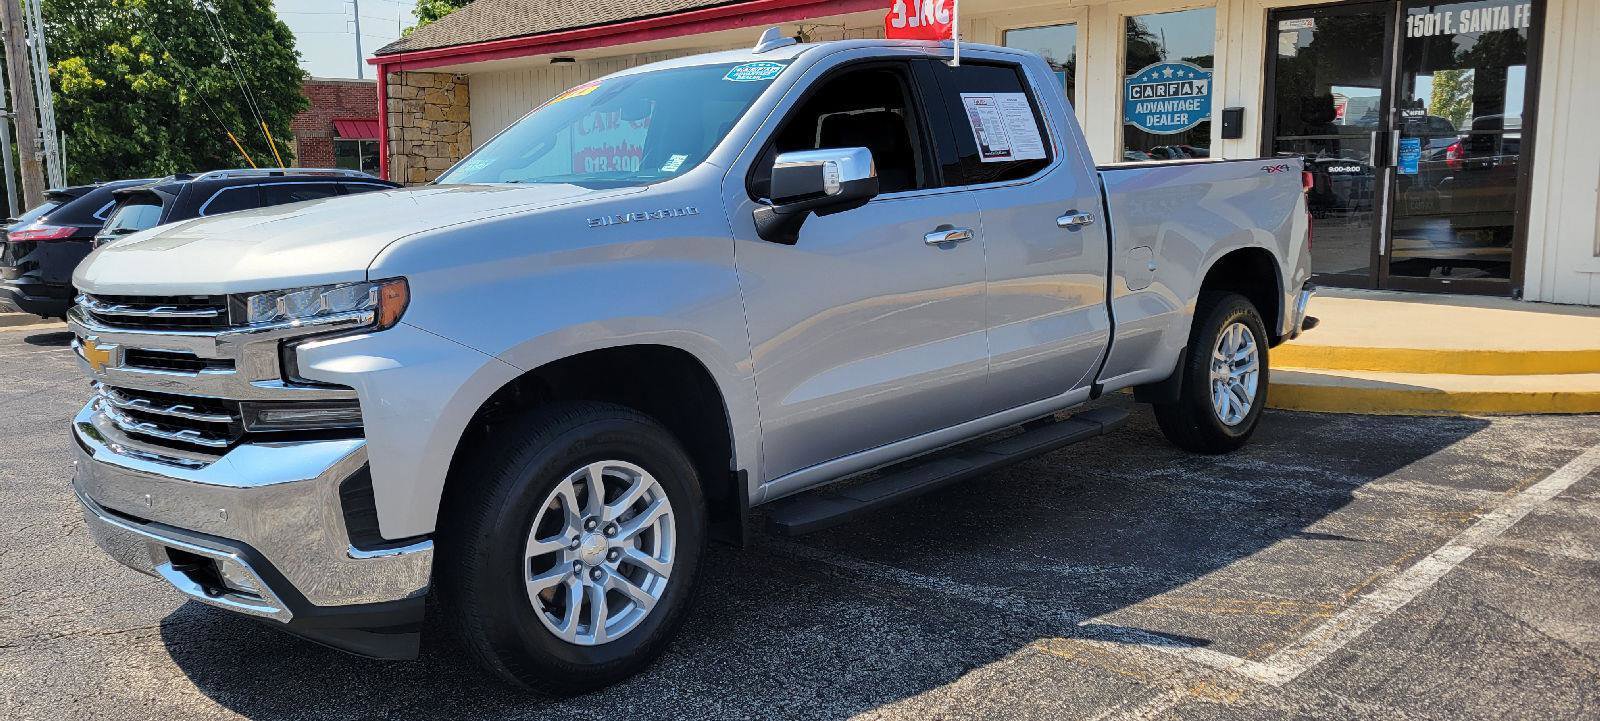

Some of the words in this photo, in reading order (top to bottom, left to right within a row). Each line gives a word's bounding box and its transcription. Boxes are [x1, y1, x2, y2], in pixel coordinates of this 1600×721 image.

[1407, 13, 1441, 37] 1501
[1444, 11, 1457, 35] E.
[1460, 6, 1510, 33] SANTA
[1514, 4, 1532, 28] FE
[1131, 82, 1206, 98] CARFAX
[1135, 99, 1201, 114] ADVANTAGE
[1146, 113, 1189, 126] DEALER
[587, 206, 700, 228] SILVERADO
